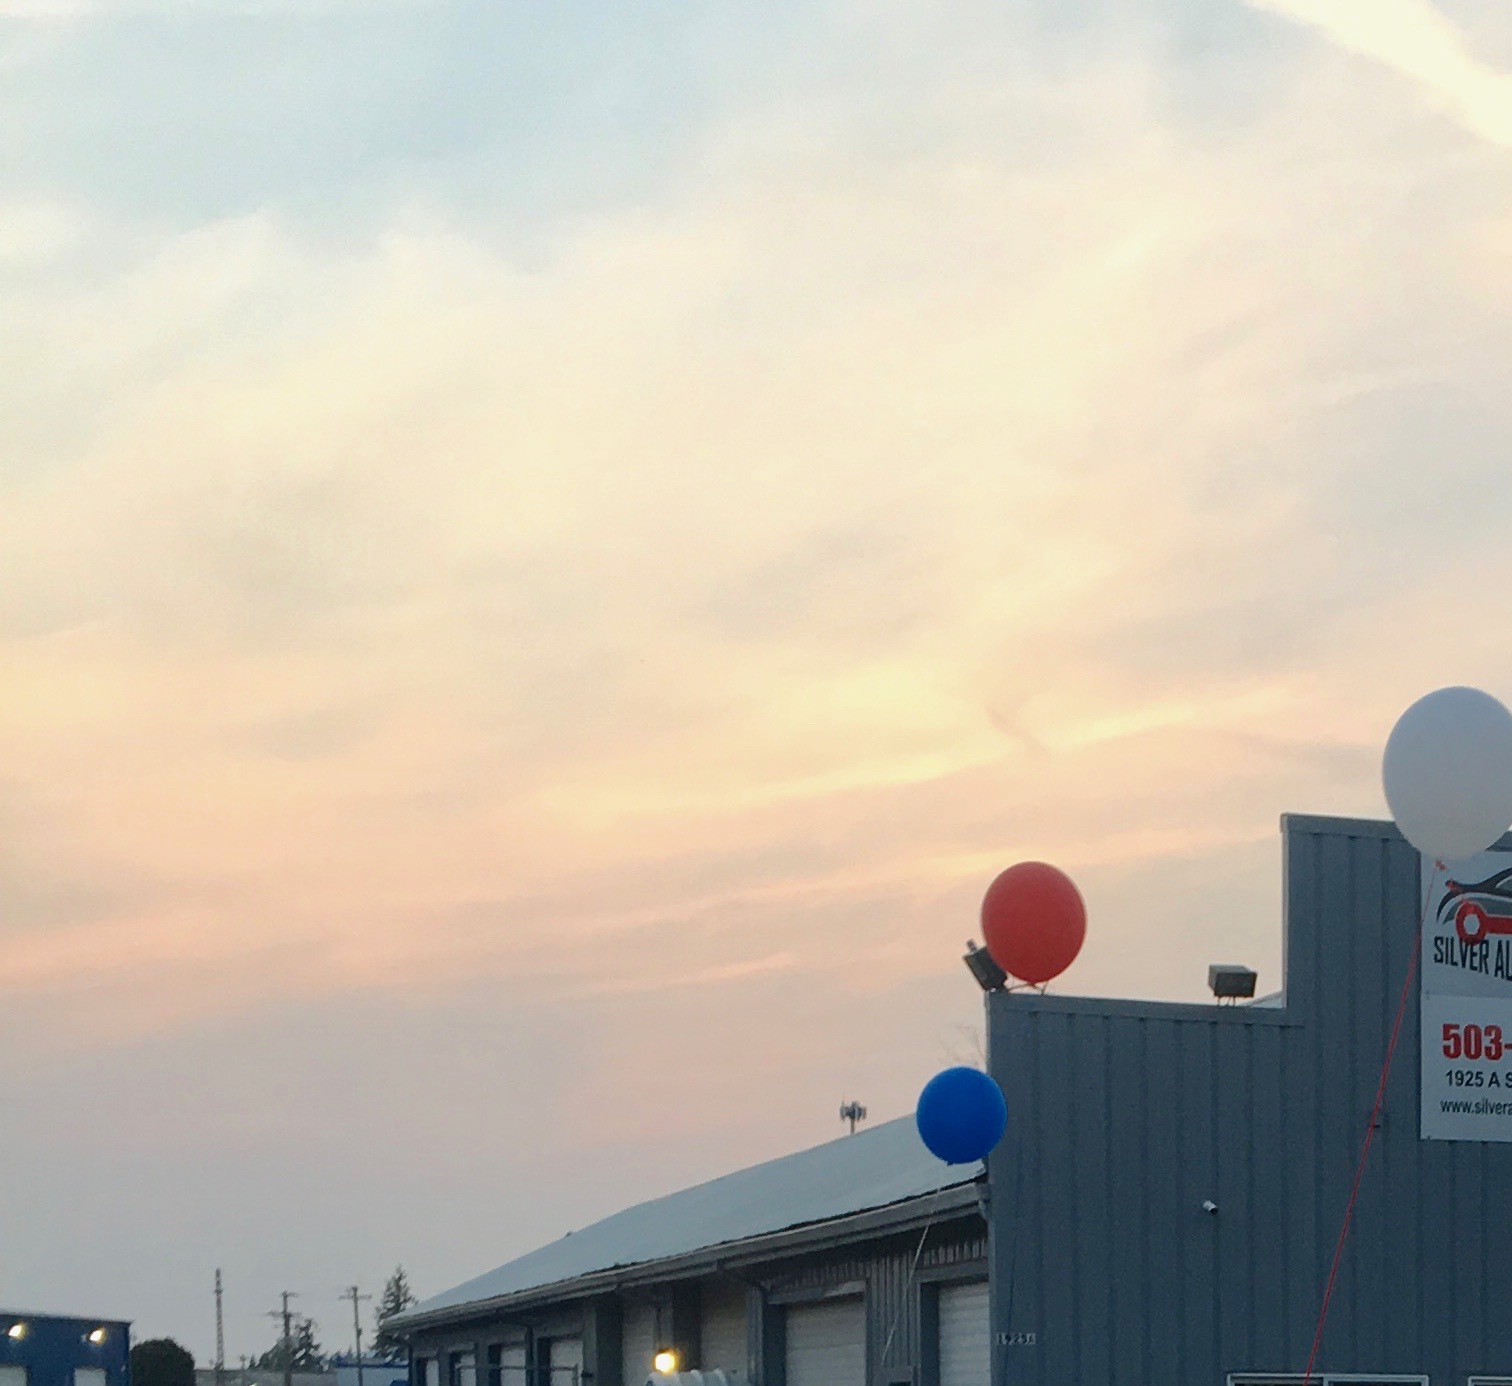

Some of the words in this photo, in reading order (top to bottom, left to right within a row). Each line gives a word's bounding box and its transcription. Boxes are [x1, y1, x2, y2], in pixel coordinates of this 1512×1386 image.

[1433, 936, 1489, 975] SILVER
[1445, 1070, 1484, 1088] 1925
[1488, 1072, 1500, 1089] A
